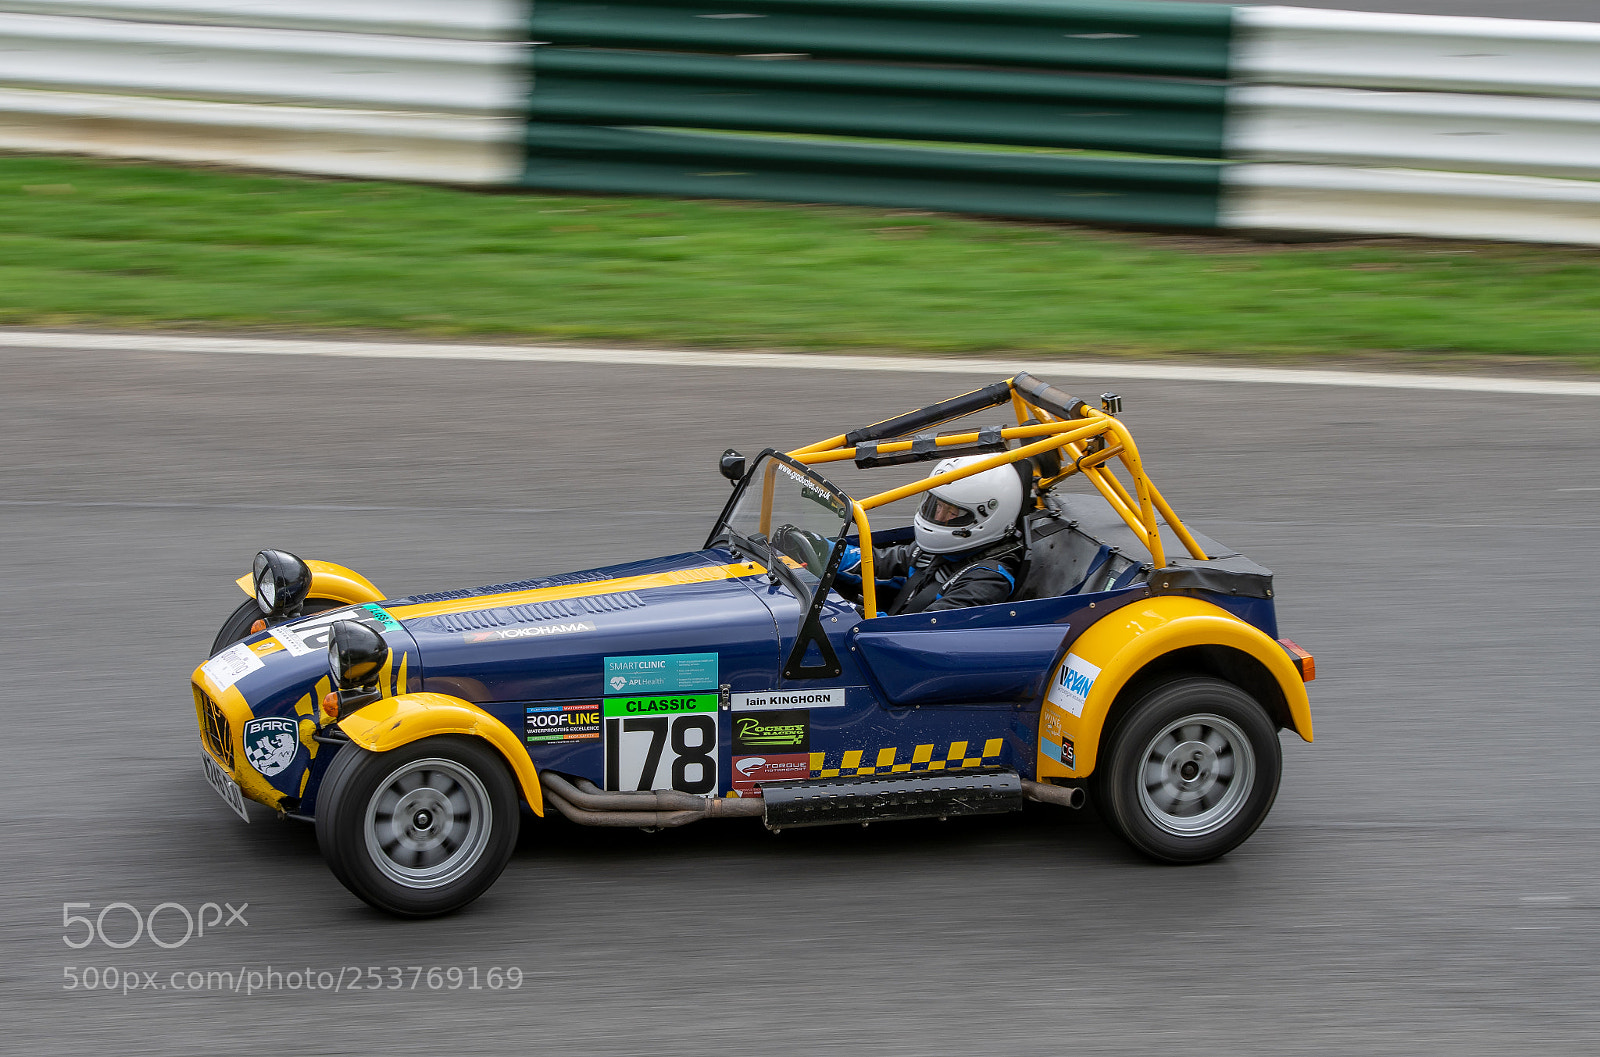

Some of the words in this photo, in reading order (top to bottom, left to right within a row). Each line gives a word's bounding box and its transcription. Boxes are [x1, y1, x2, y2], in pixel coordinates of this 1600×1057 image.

[496, 623, 589, 638] YOKOHAMA
[610, 661, 665, 670] SMARTCLINIC
[626, 699, 697, 712] CLASSIC
[746, 698, 766, 706] Iain
[770, 695, 831, 705] KINGHORN
[527, 713, 599, 727] ROOFLINE
[250, 721, 293, 734] BARC
[606, 715, 716, 794] 178
